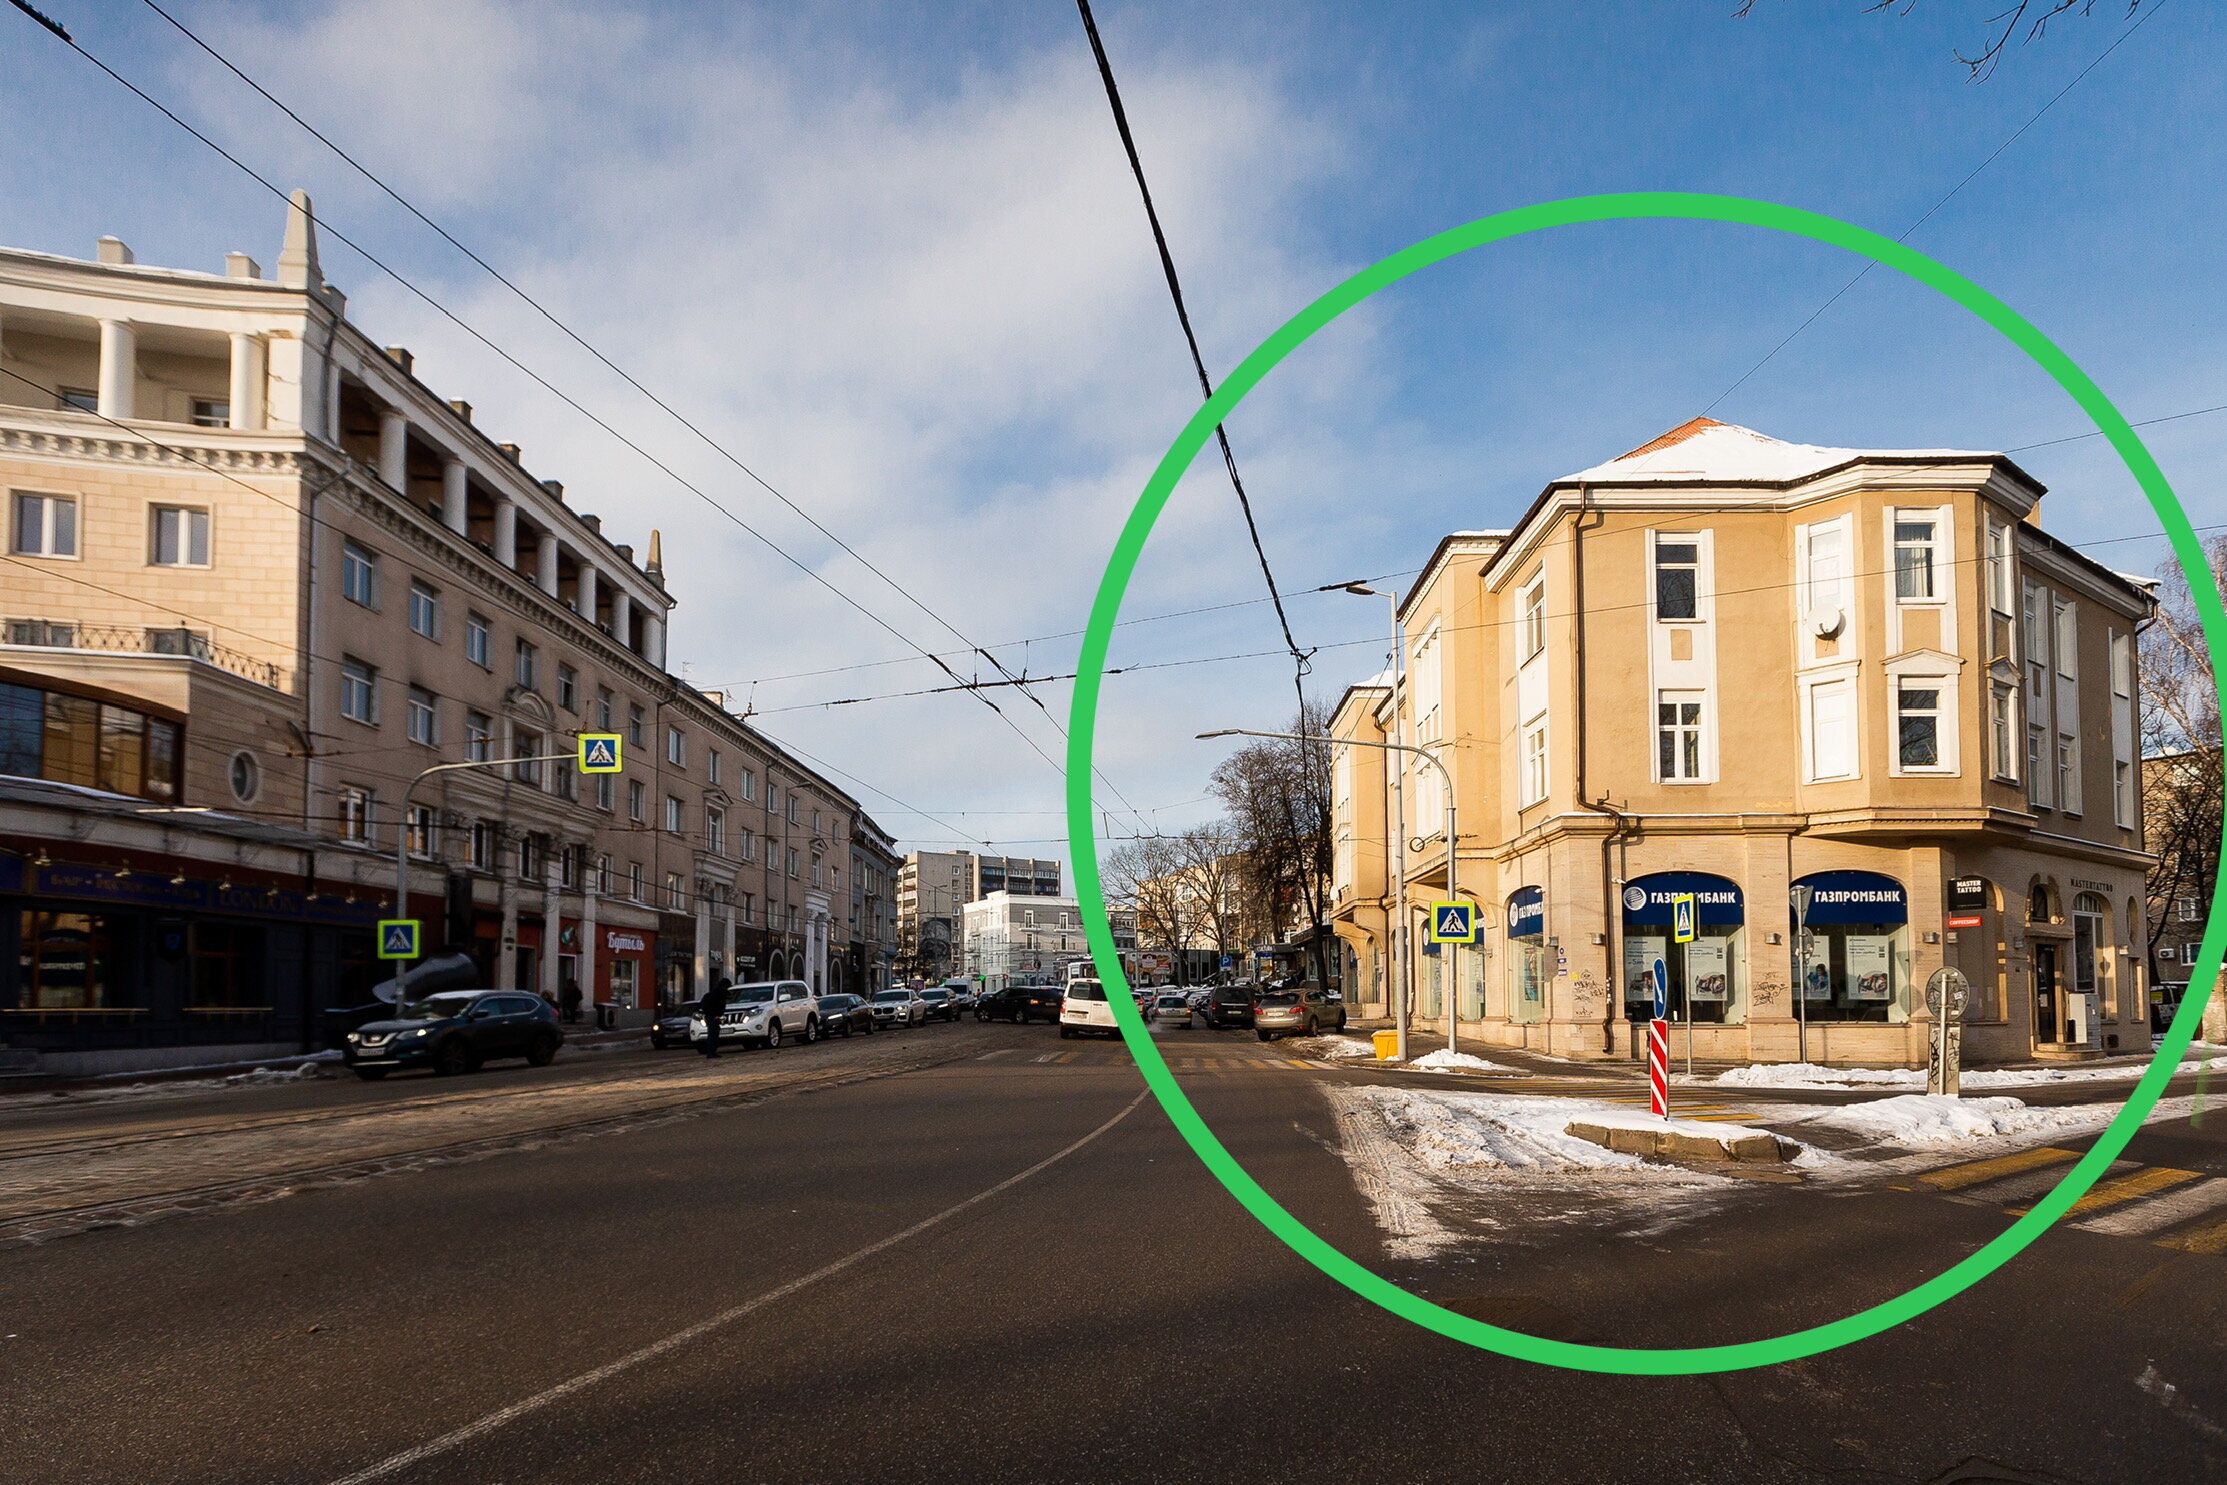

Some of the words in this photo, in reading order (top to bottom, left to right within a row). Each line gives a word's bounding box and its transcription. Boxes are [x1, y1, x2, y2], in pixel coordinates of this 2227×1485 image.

[1957, 886, 1982, 894] TATTOO
[2070, 878, 2113, 892] MASTERTATTOO
[1651, 892, 1736, 904] ГАЗПМБАНК
[1815, 890, 1900, 903] ГАЗПРОМБАНК
[607, 931, 645, 954] Бутыль
[1222, 957, 1230, 966] P
